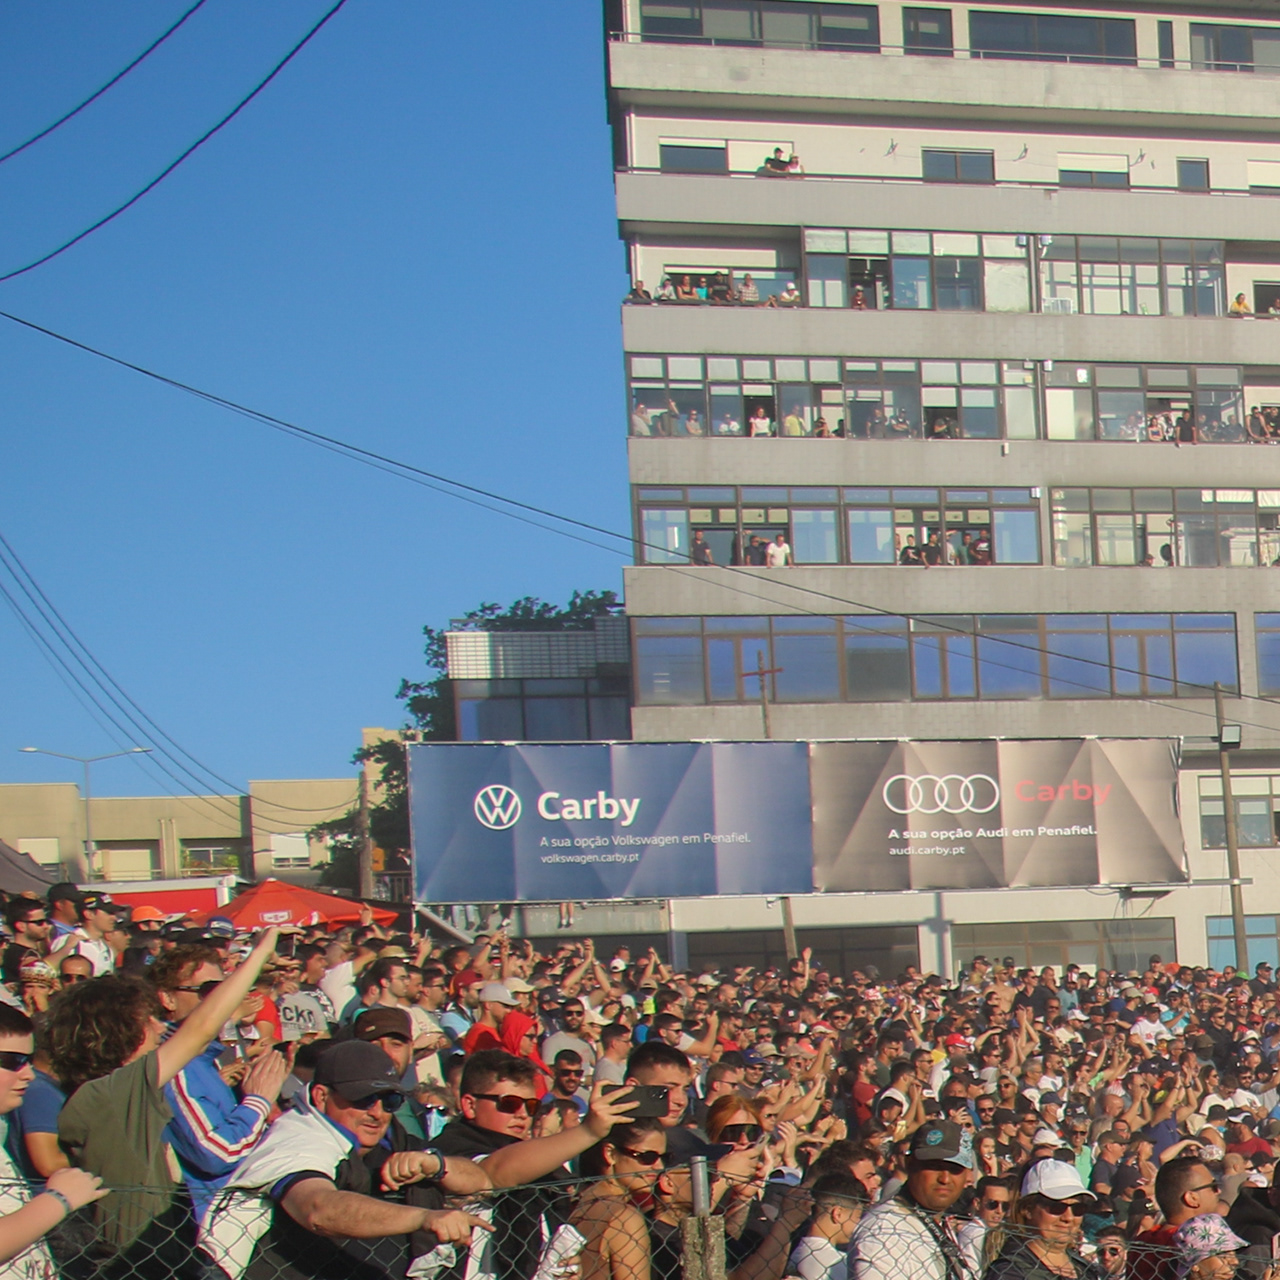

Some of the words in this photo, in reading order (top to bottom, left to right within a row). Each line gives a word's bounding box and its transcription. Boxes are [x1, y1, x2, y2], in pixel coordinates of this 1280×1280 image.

[1014, 779, 1112, 805] Carby
[537, 790, 641, 827] Carby
[540, 836, 549, 848] A
[551, 838, 571, 848] sua
[574, 835, 609, 851] opção
[611, 834, 679, 849] Volkswagen
[682, 834, 700, 845] em
[704, 832, 751, 844] Penafiel.
[888, 828, 900, 839] A
[903, 830, 927, 839] sua
[930, 827, 972, 841] opção
[976, 827, 1008, 838] Audi
[1012, 827, 1034, 837] em
[1038, 825, 1097, 837] Penafiel.
[541, 852, 639, 866] volkswagen.carby.pt
[889, 845, 965, 857] audi.carby.pt
